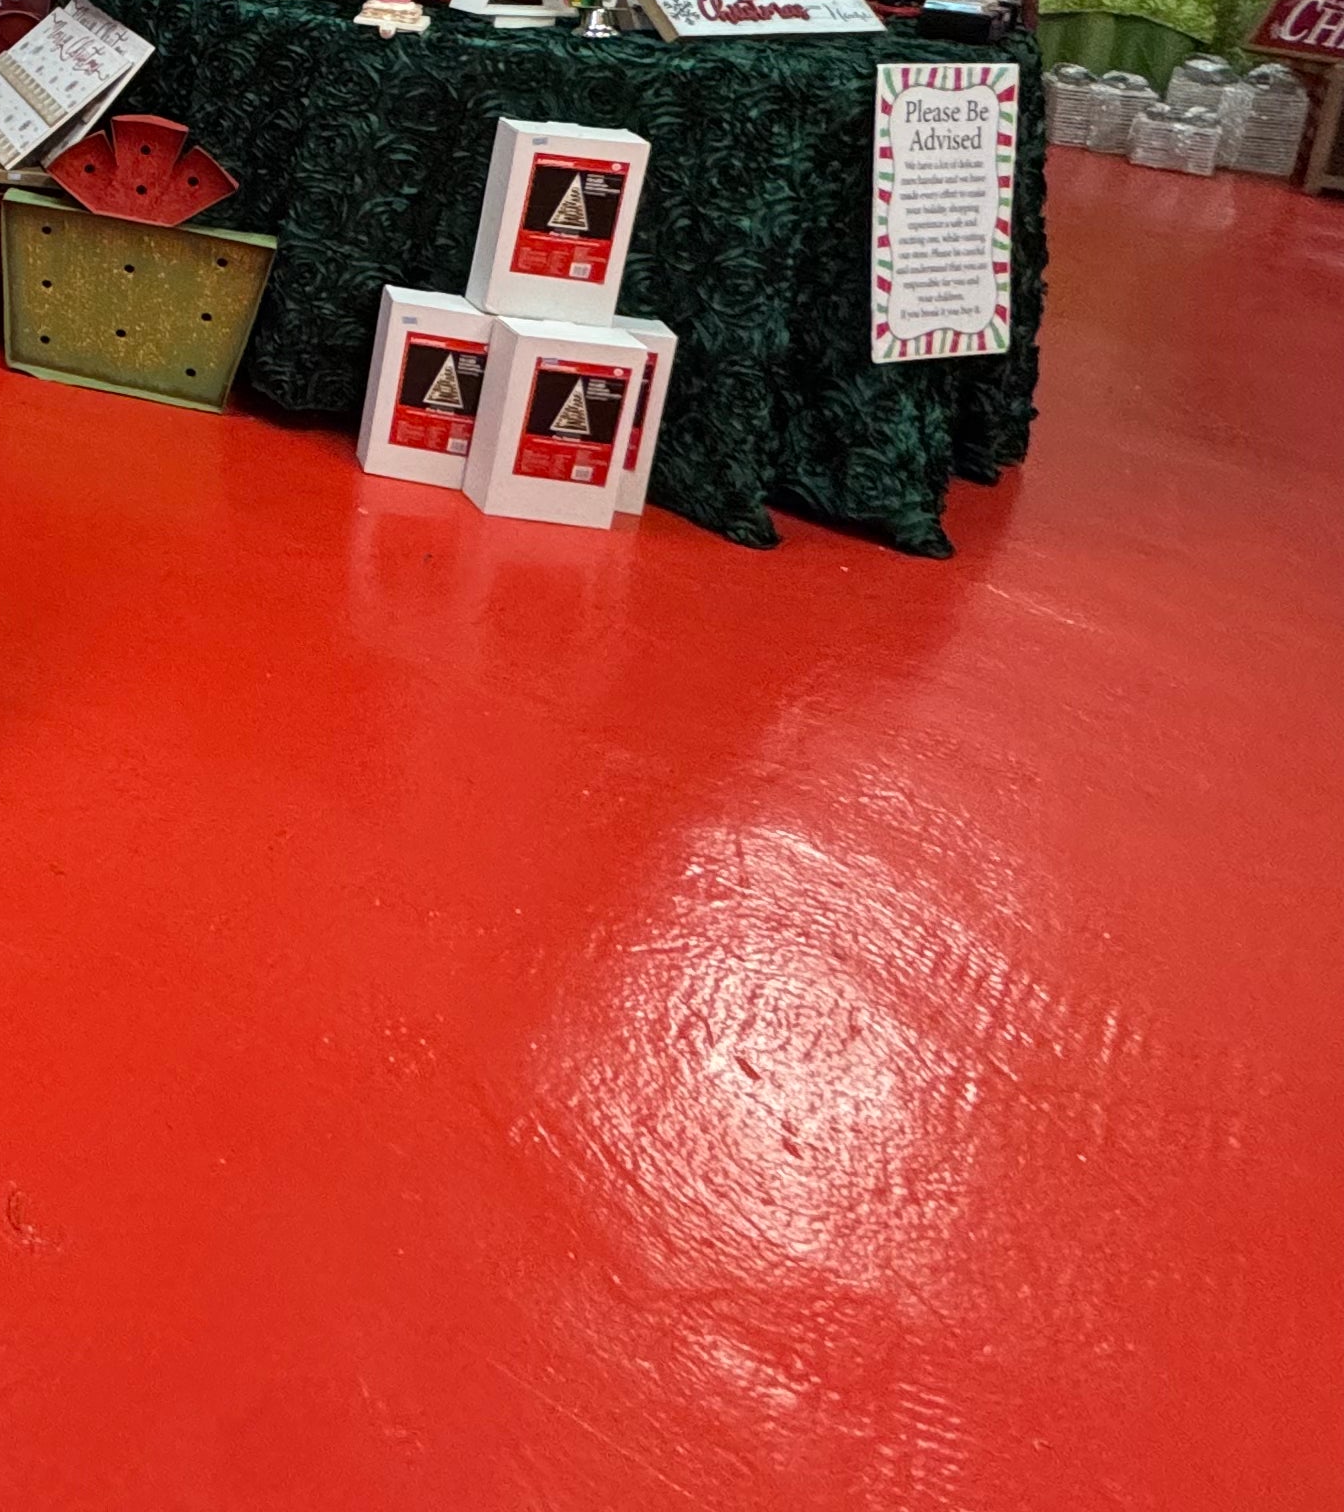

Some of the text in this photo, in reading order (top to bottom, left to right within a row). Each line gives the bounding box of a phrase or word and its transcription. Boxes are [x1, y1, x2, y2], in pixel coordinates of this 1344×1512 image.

[905, 100, 990, 124] Please Be
[909, 127, 982, 151] Advised
